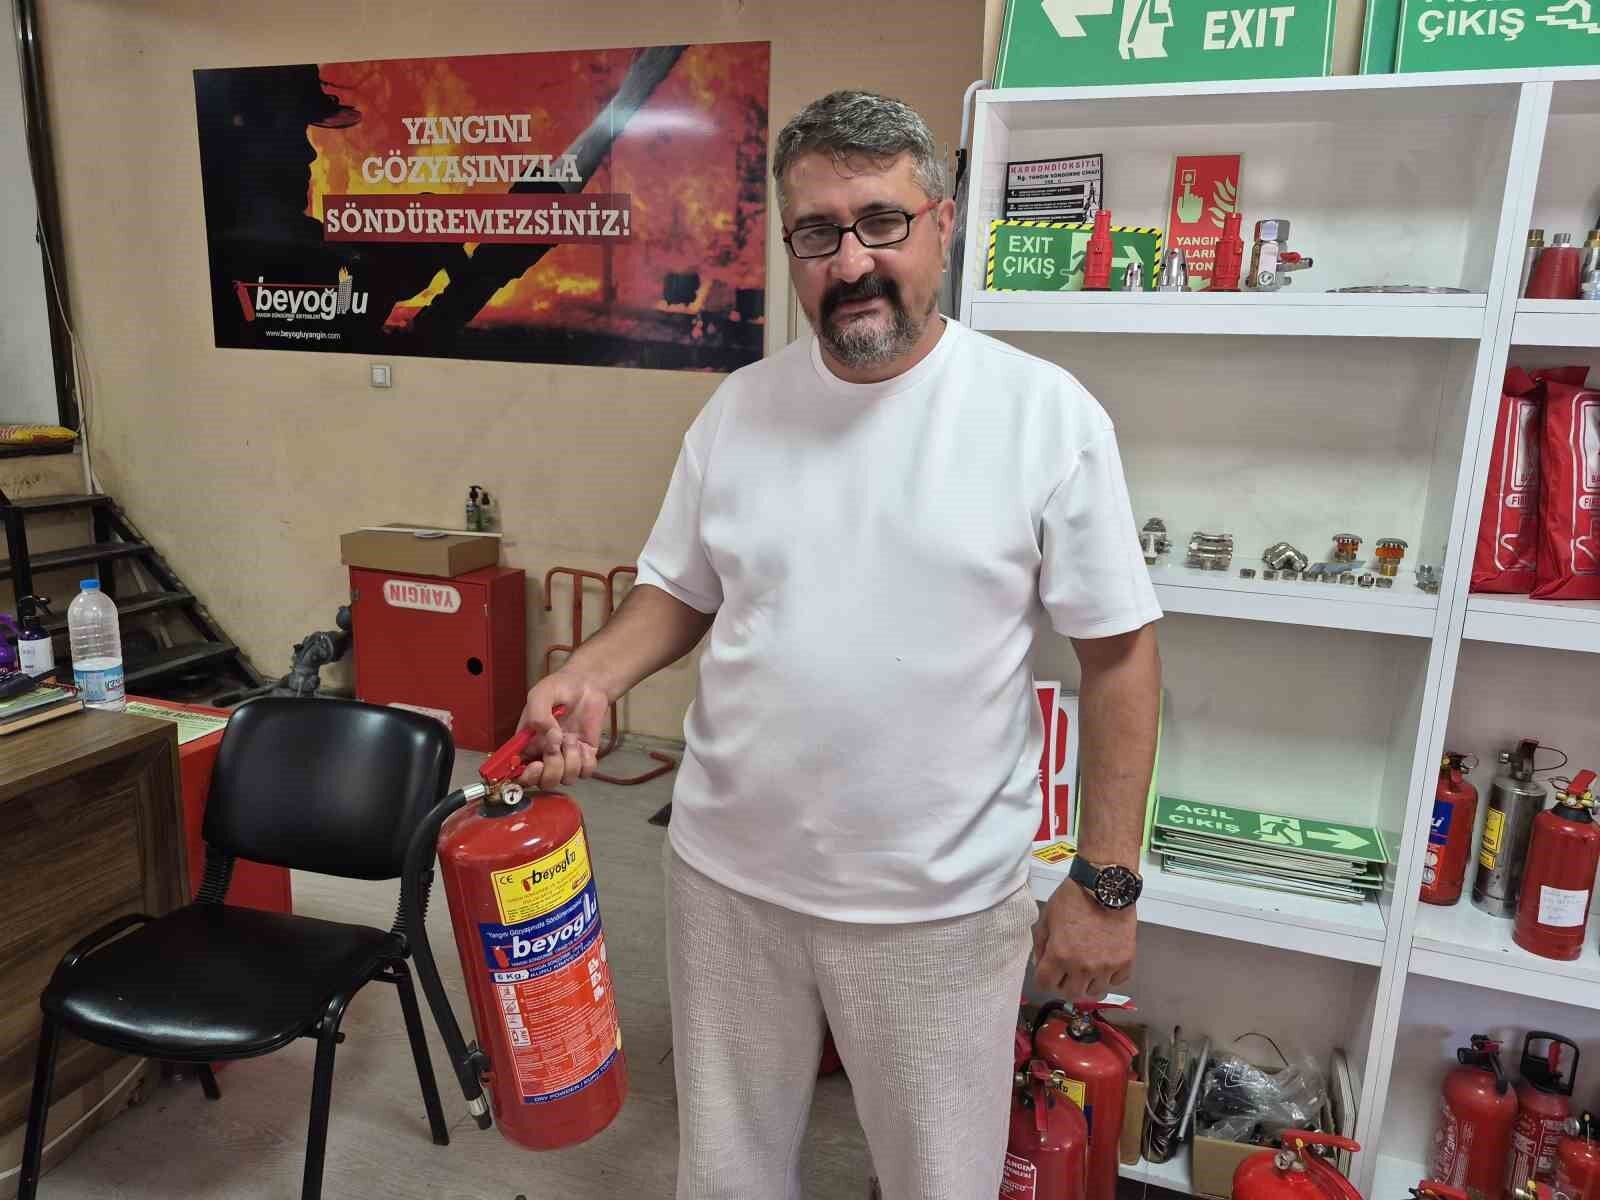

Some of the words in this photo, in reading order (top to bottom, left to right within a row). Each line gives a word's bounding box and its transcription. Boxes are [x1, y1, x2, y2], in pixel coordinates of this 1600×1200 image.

[1203, 7, 1295, 50] EXIT
[1417, 8, 1526, 43] ÇIKIŞ
[402, 114, 532, 145] YANGINI
[362, 150, 582, 187] GÖZYAŞINIZLA
[326, 200, 631, 237] SÖNDÜREMEZSİNİZ!
[1008, 236, 1053, 254] EXIT
[1185, 249, 1216, 258] LAR
[1002, 256, 1056, 277] ÇIKIŞ
[389, 584, 454, 608] YANGIN
[1175, 803, 1234, 820] ACİL
[1169, 815, 1241, 833] ÇIKIŞ
